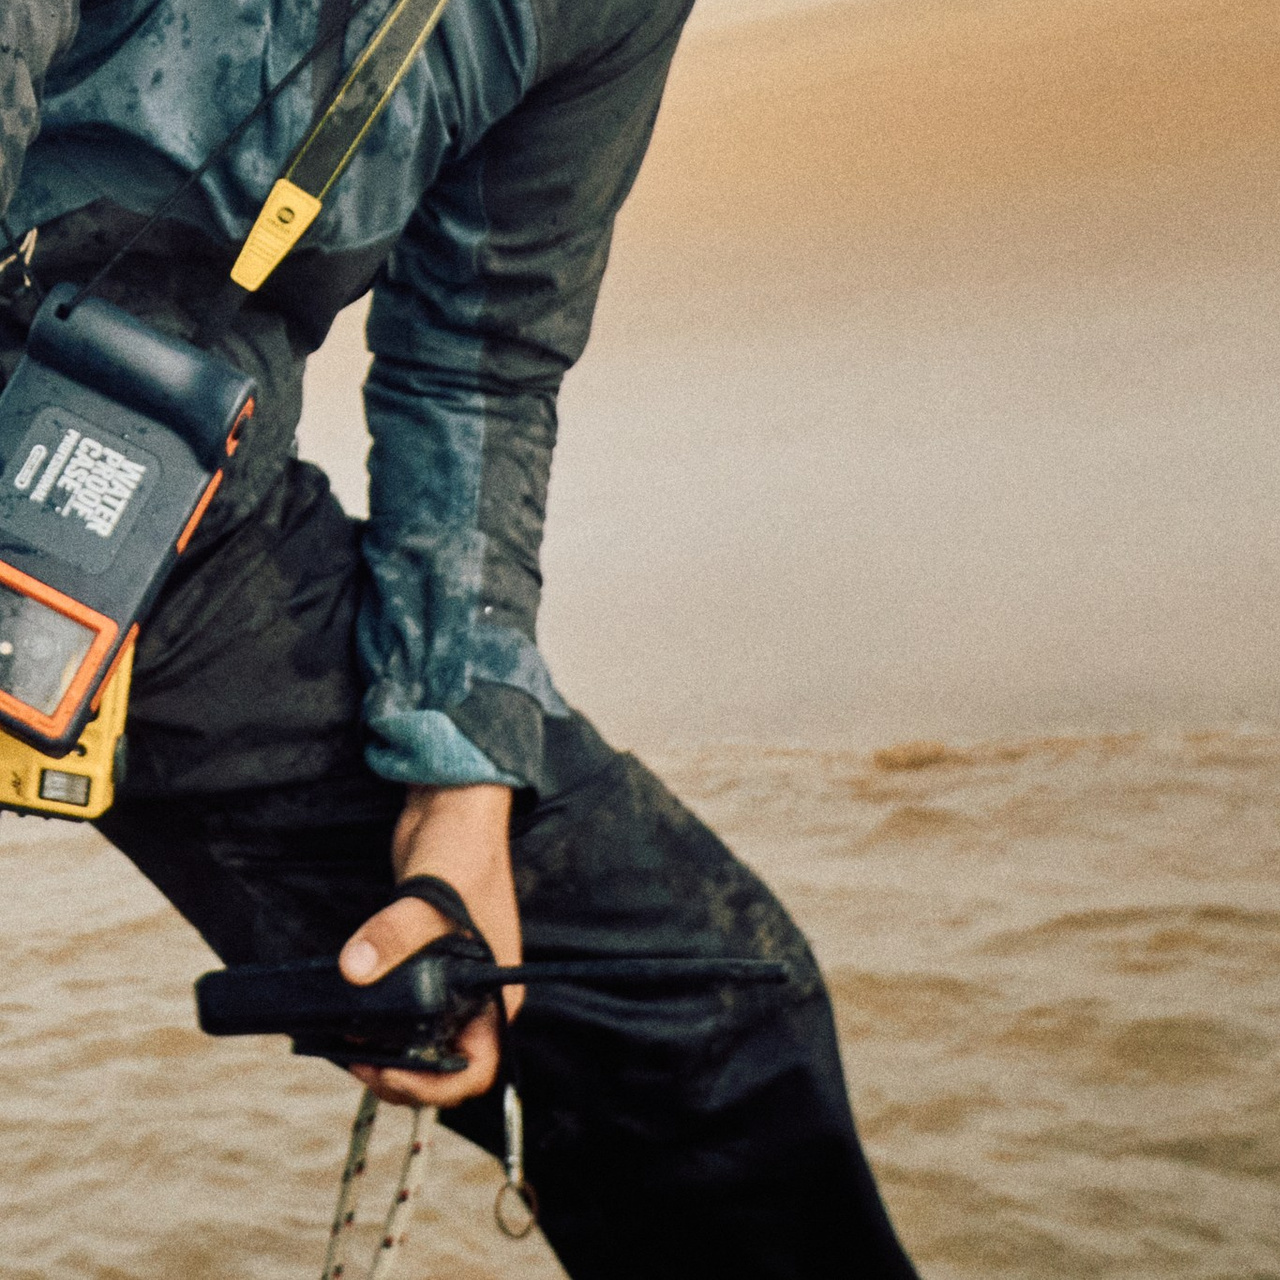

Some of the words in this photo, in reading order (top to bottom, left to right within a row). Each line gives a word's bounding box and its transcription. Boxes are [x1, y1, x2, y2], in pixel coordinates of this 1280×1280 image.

[56, 437, 103, 495] CASE
[69, 446, 125, 521] PROOF
[85, 458, 147, 538] WATER
